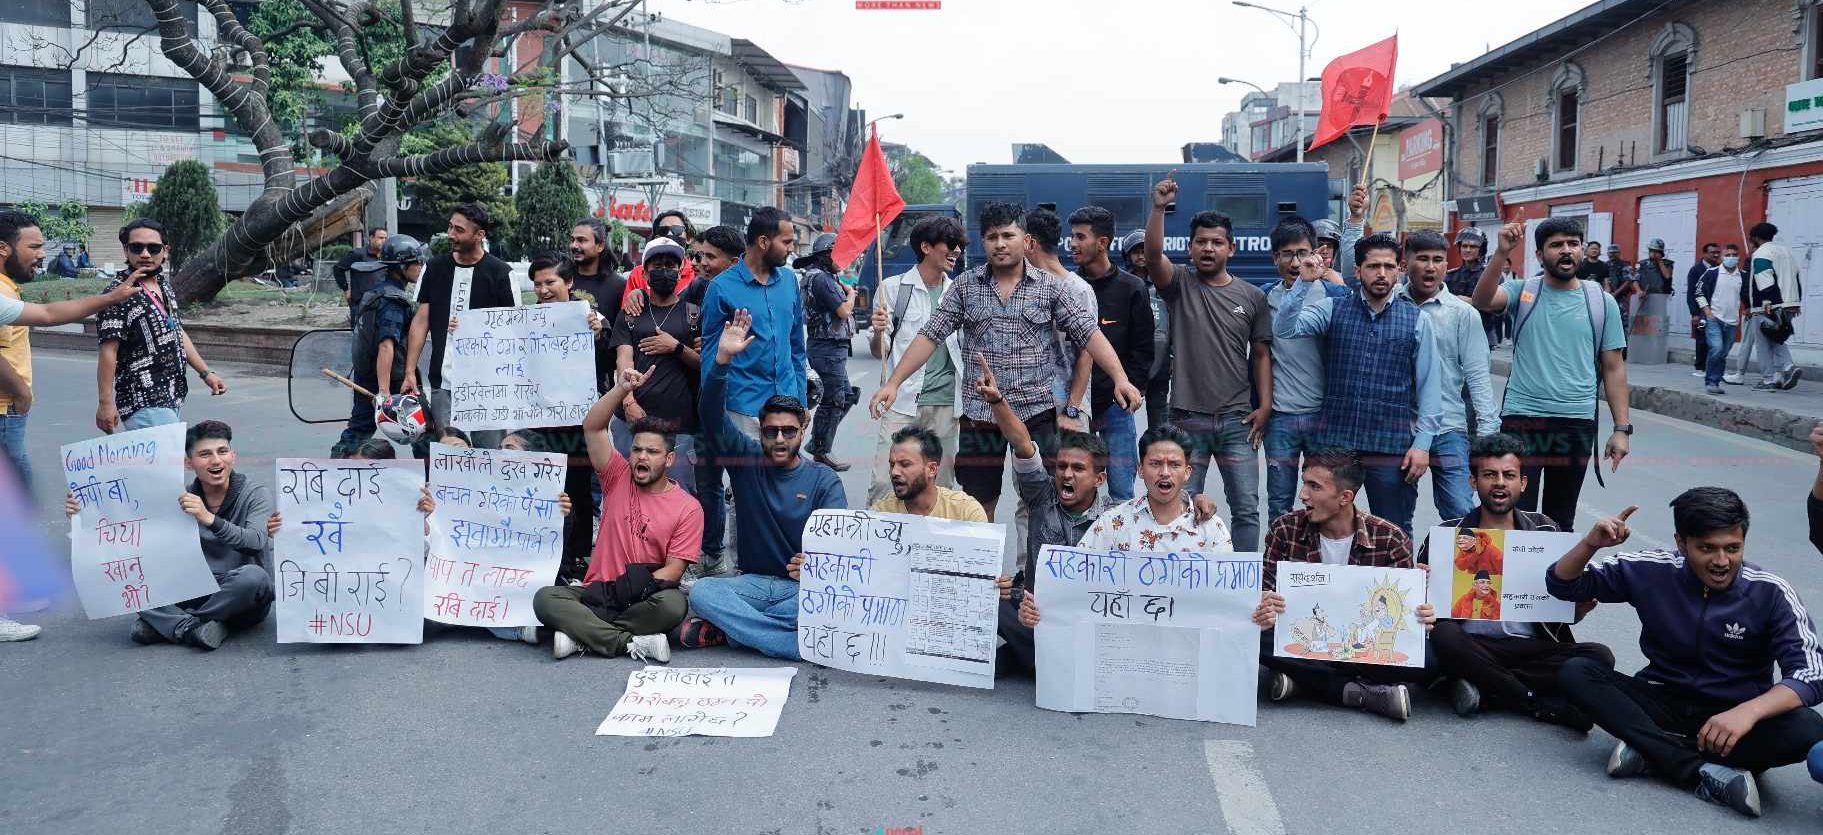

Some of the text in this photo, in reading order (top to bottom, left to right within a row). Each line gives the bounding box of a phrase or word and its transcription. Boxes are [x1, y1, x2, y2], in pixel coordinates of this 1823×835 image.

[683, 207, 711, 218] SEIKO
[65, 439, 156, 472] Good Morning
[532, 457, 564, 484] गरेर
[280, 461, 388, 506] रबि दाई
[435, 484, 472, 506] बचत
[476, 485, 520, 515] गरेको
[96, 517, 148, 547] चिया
[461, 562, 480, 588] त
[803, 548, 879, 585] सहकारी
[1046, 549, 1262, 591] सहकारी ठगीको प्रमाण
[433, 592, 465, 618] रबि
[801, 585, 909, 627] ठगीको प्रमाण
[309, 608, 372, 637] #NSU
